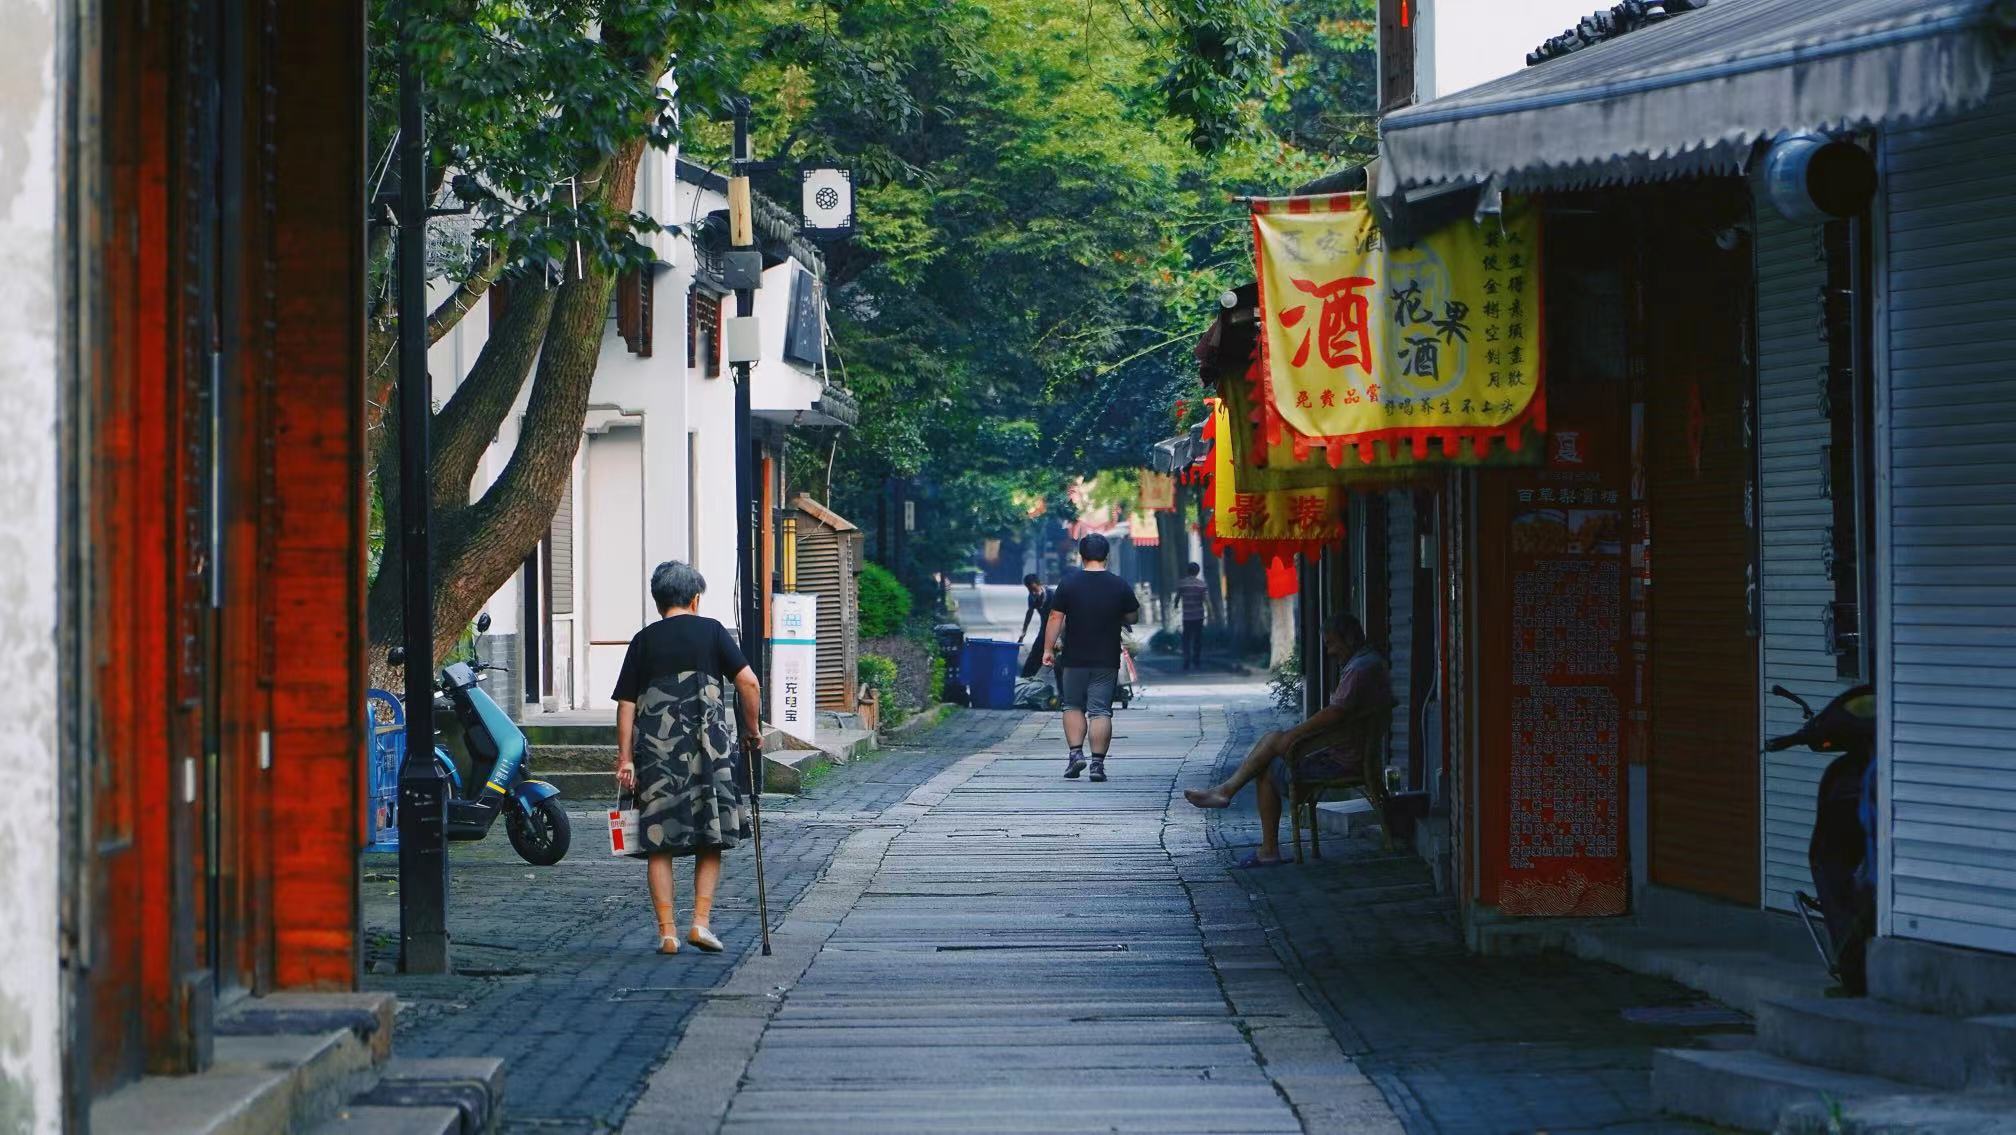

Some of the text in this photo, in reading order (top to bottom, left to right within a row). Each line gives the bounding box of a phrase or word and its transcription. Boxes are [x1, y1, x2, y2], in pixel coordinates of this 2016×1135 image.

[1278, 275, 1377, 375] 酒
[785, 682, 798, 722] 充电宝
